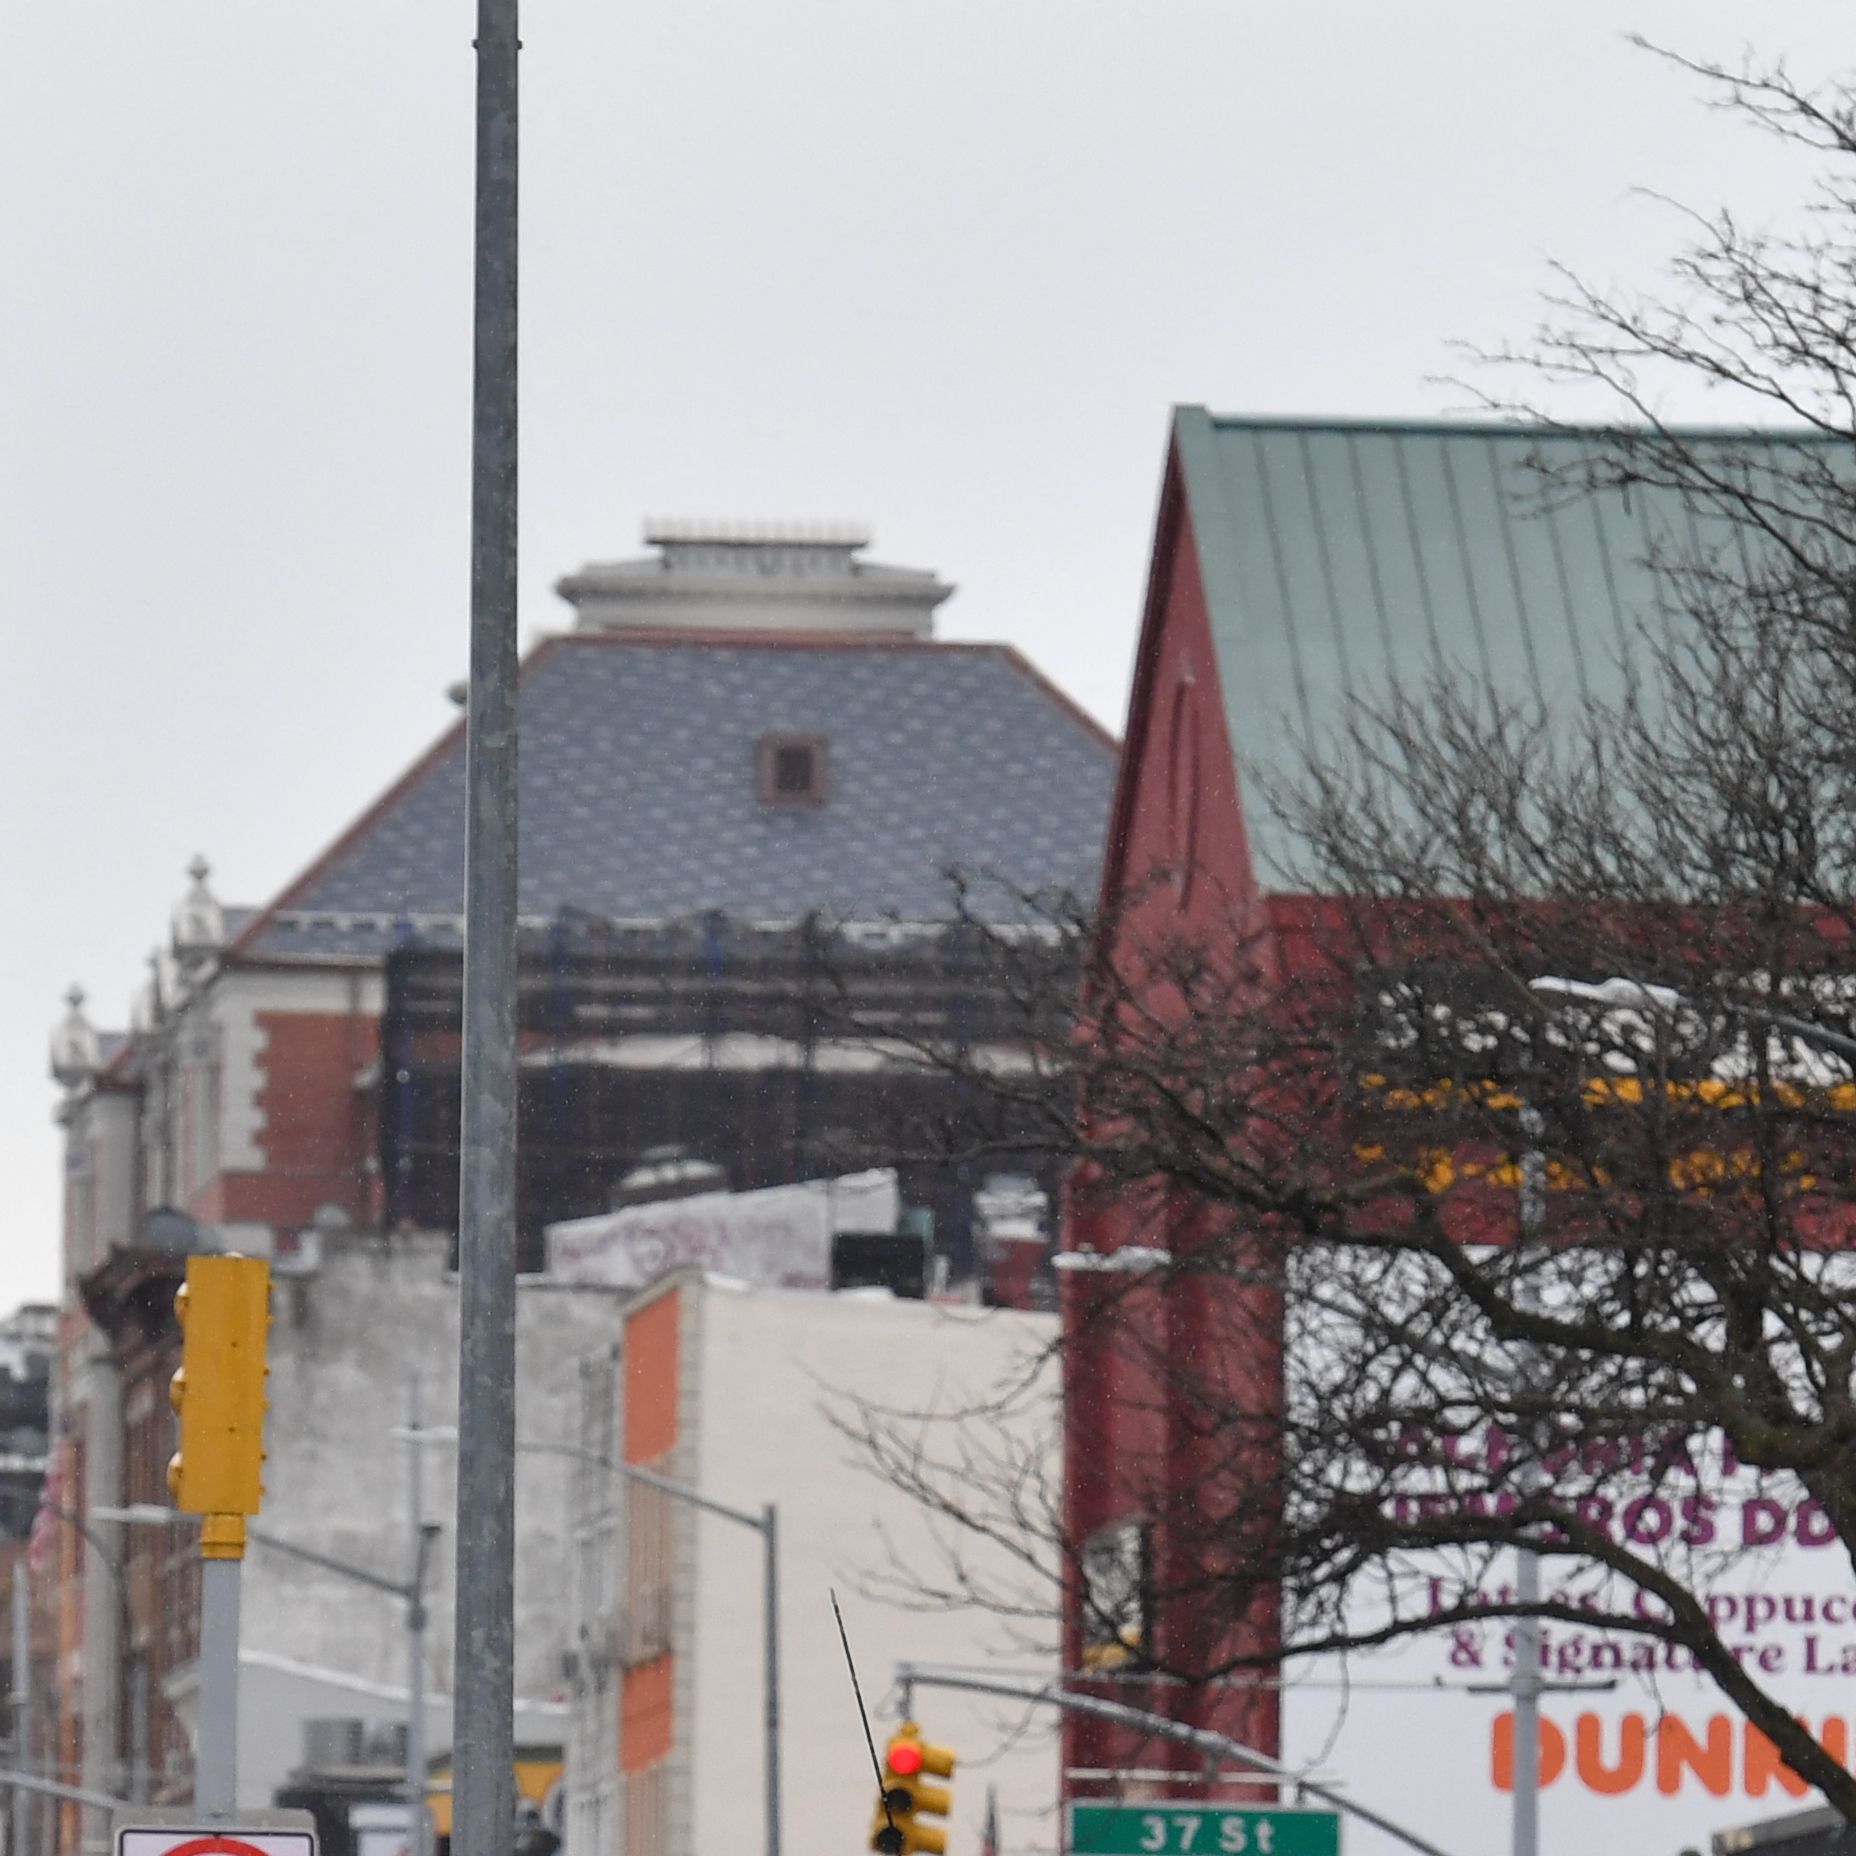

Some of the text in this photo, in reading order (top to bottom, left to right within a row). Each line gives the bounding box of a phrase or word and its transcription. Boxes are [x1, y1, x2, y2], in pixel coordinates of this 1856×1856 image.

[1449, 1626, 1482, 1669] &
[1140, 1815, 1276, 1854] 37 St
